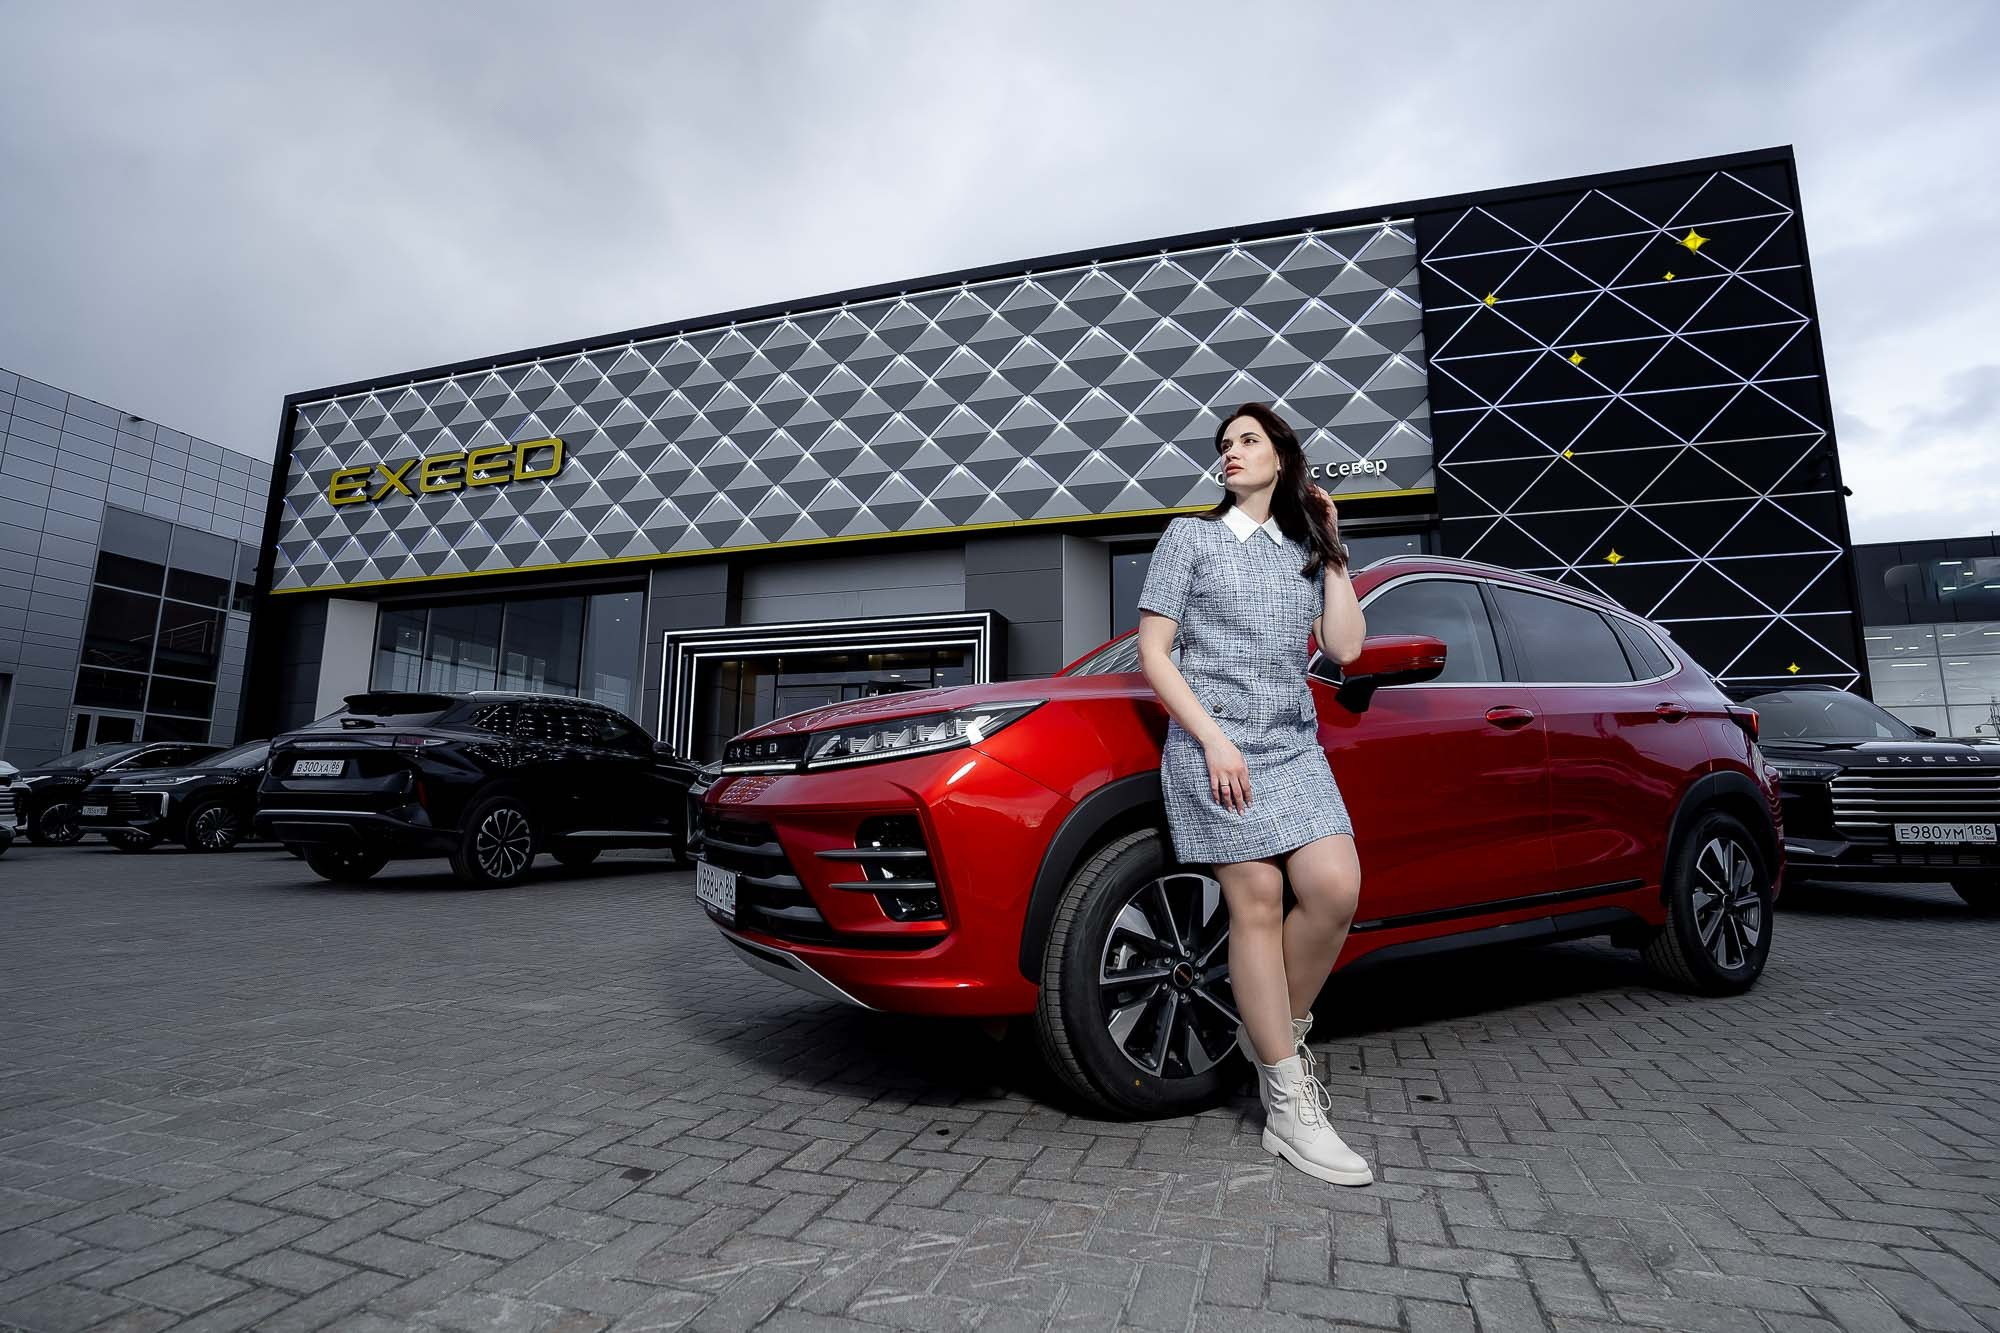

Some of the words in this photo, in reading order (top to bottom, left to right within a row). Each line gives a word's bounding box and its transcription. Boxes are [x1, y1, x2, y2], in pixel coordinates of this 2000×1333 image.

[328, 438, 564, 505] EXEED
[1325, 459, 1388, 478] Север
[1967, 824, 1992, 836] 186
